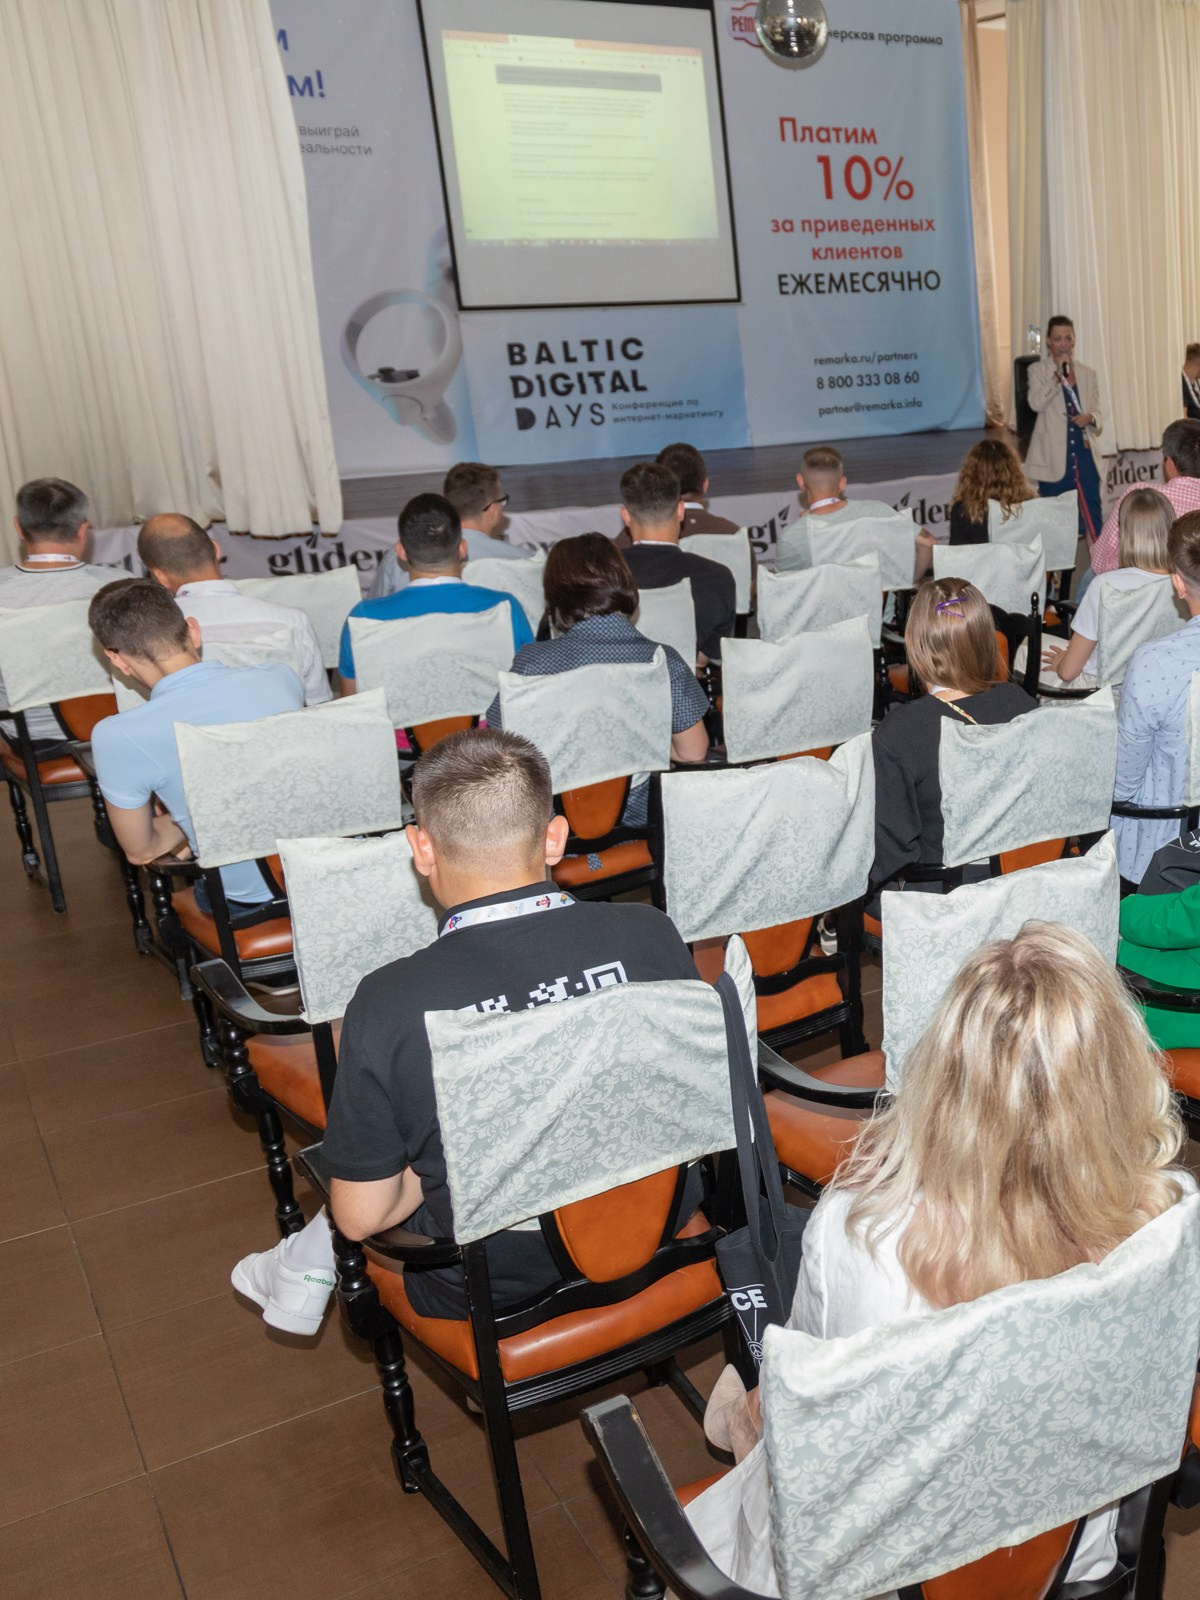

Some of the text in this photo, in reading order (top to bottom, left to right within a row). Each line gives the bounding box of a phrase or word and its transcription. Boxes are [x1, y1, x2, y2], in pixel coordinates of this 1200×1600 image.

[878, 32, 943, 46] программа
[299, 125, 360, 139] выиграй
[779, 116, 877, 145] Платим
[817, 154, 914, 201] 10%
[771, 218, 936, 239] за приведенных
[812, 245, 903, 260] клиентов
[778, 270, 941, 295] ЕЖЕМЕСЯЧНО
[507, 337, 644, 366] BALTIC
[814, 351, 918, 366] remarka.ru/partners
[510, 369, 648, 399] DIGITAL
[817, 370, 920, 390] 8 800 333 08 60
[515, 401, 605, 431] DAYS
[611, 401, 684, 411] Конференция
[818, 399, 923, 418] partner@remarka.info
[613, 410, 724, 424] интернет-маркетингу
[1106, 454, 1159, 495] glider
